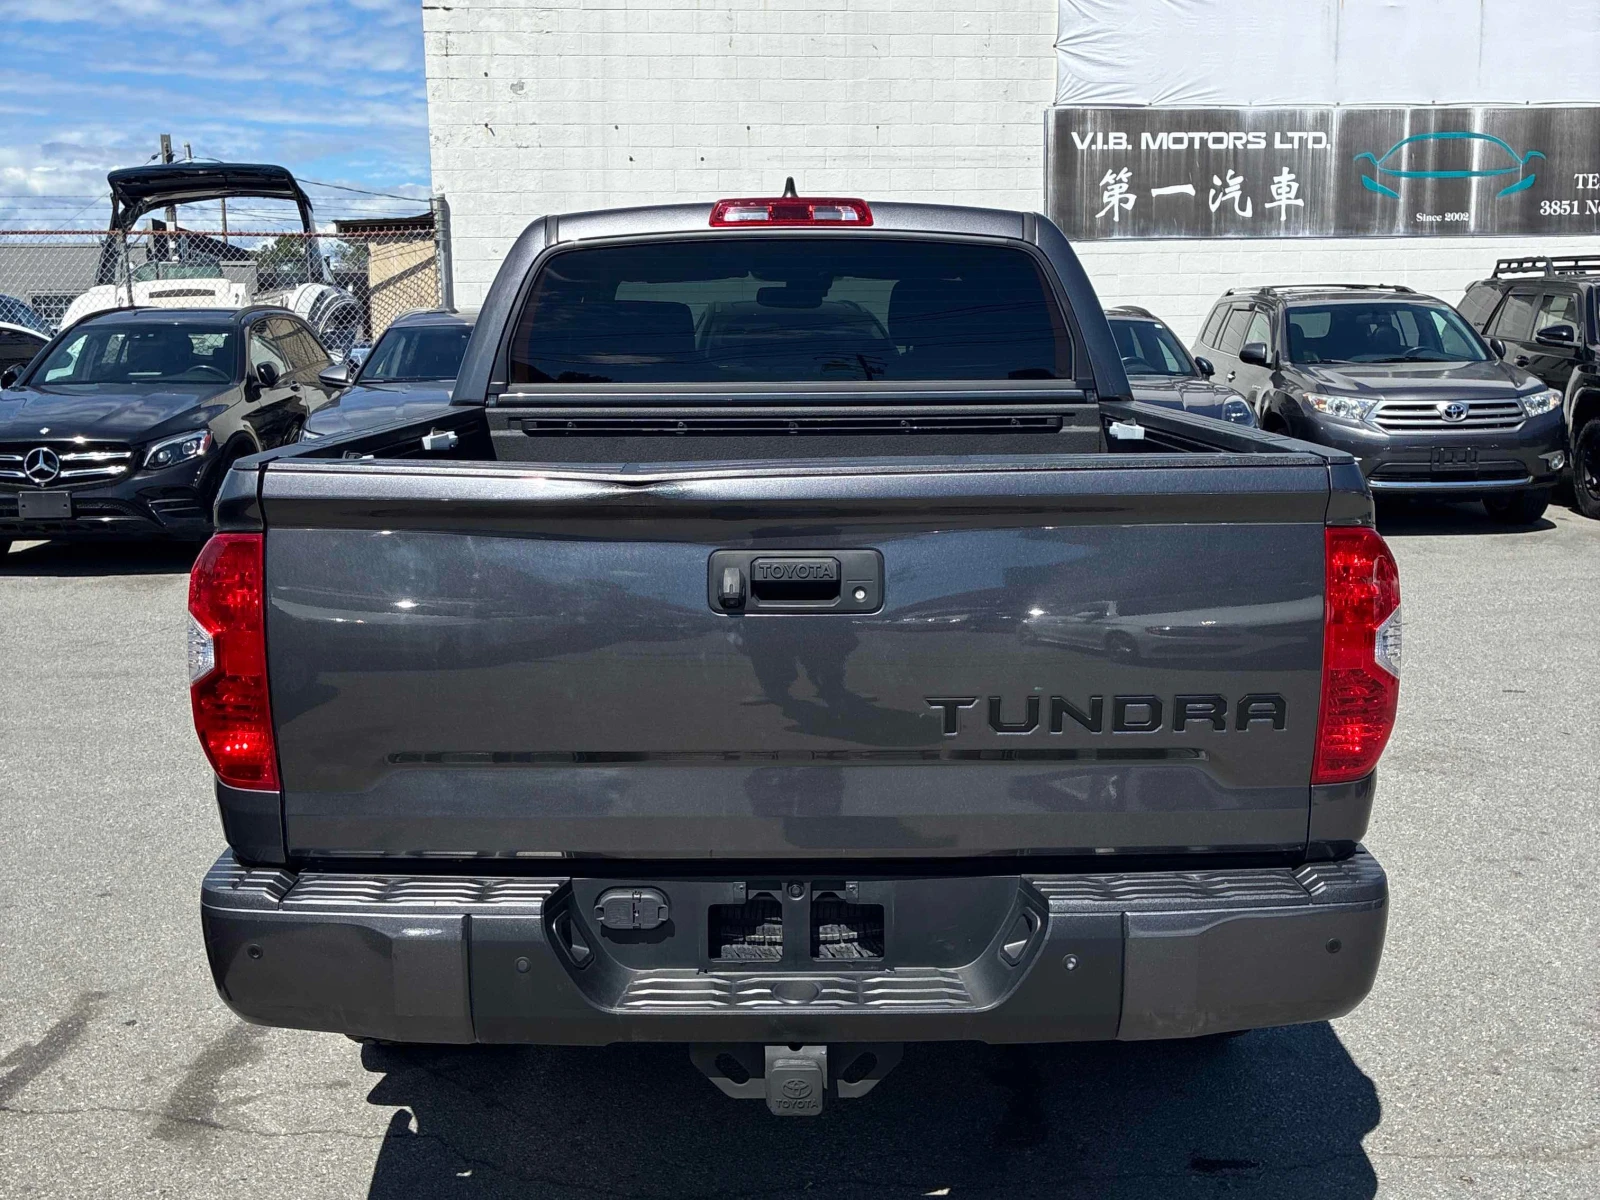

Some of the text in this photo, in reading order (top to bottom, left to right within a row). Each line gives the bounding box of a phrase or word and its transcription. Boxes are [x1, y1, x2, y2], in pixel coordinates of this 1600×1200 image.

[1071, 131, 1132, 150] V.I.B.
[1140, 131, 1267, 150] MOTORS
[1095, 166, 1305, 222] 第一汽車
[1540, 199, 1580, 216] 3851
[1415, 212, 1469, 222] Since 2002
[758, 563, 834, 580] TOYOTA
[925, 693, 1287, 735] TUNDRA
[775, 1099, 819, 1109] TOYOTA
